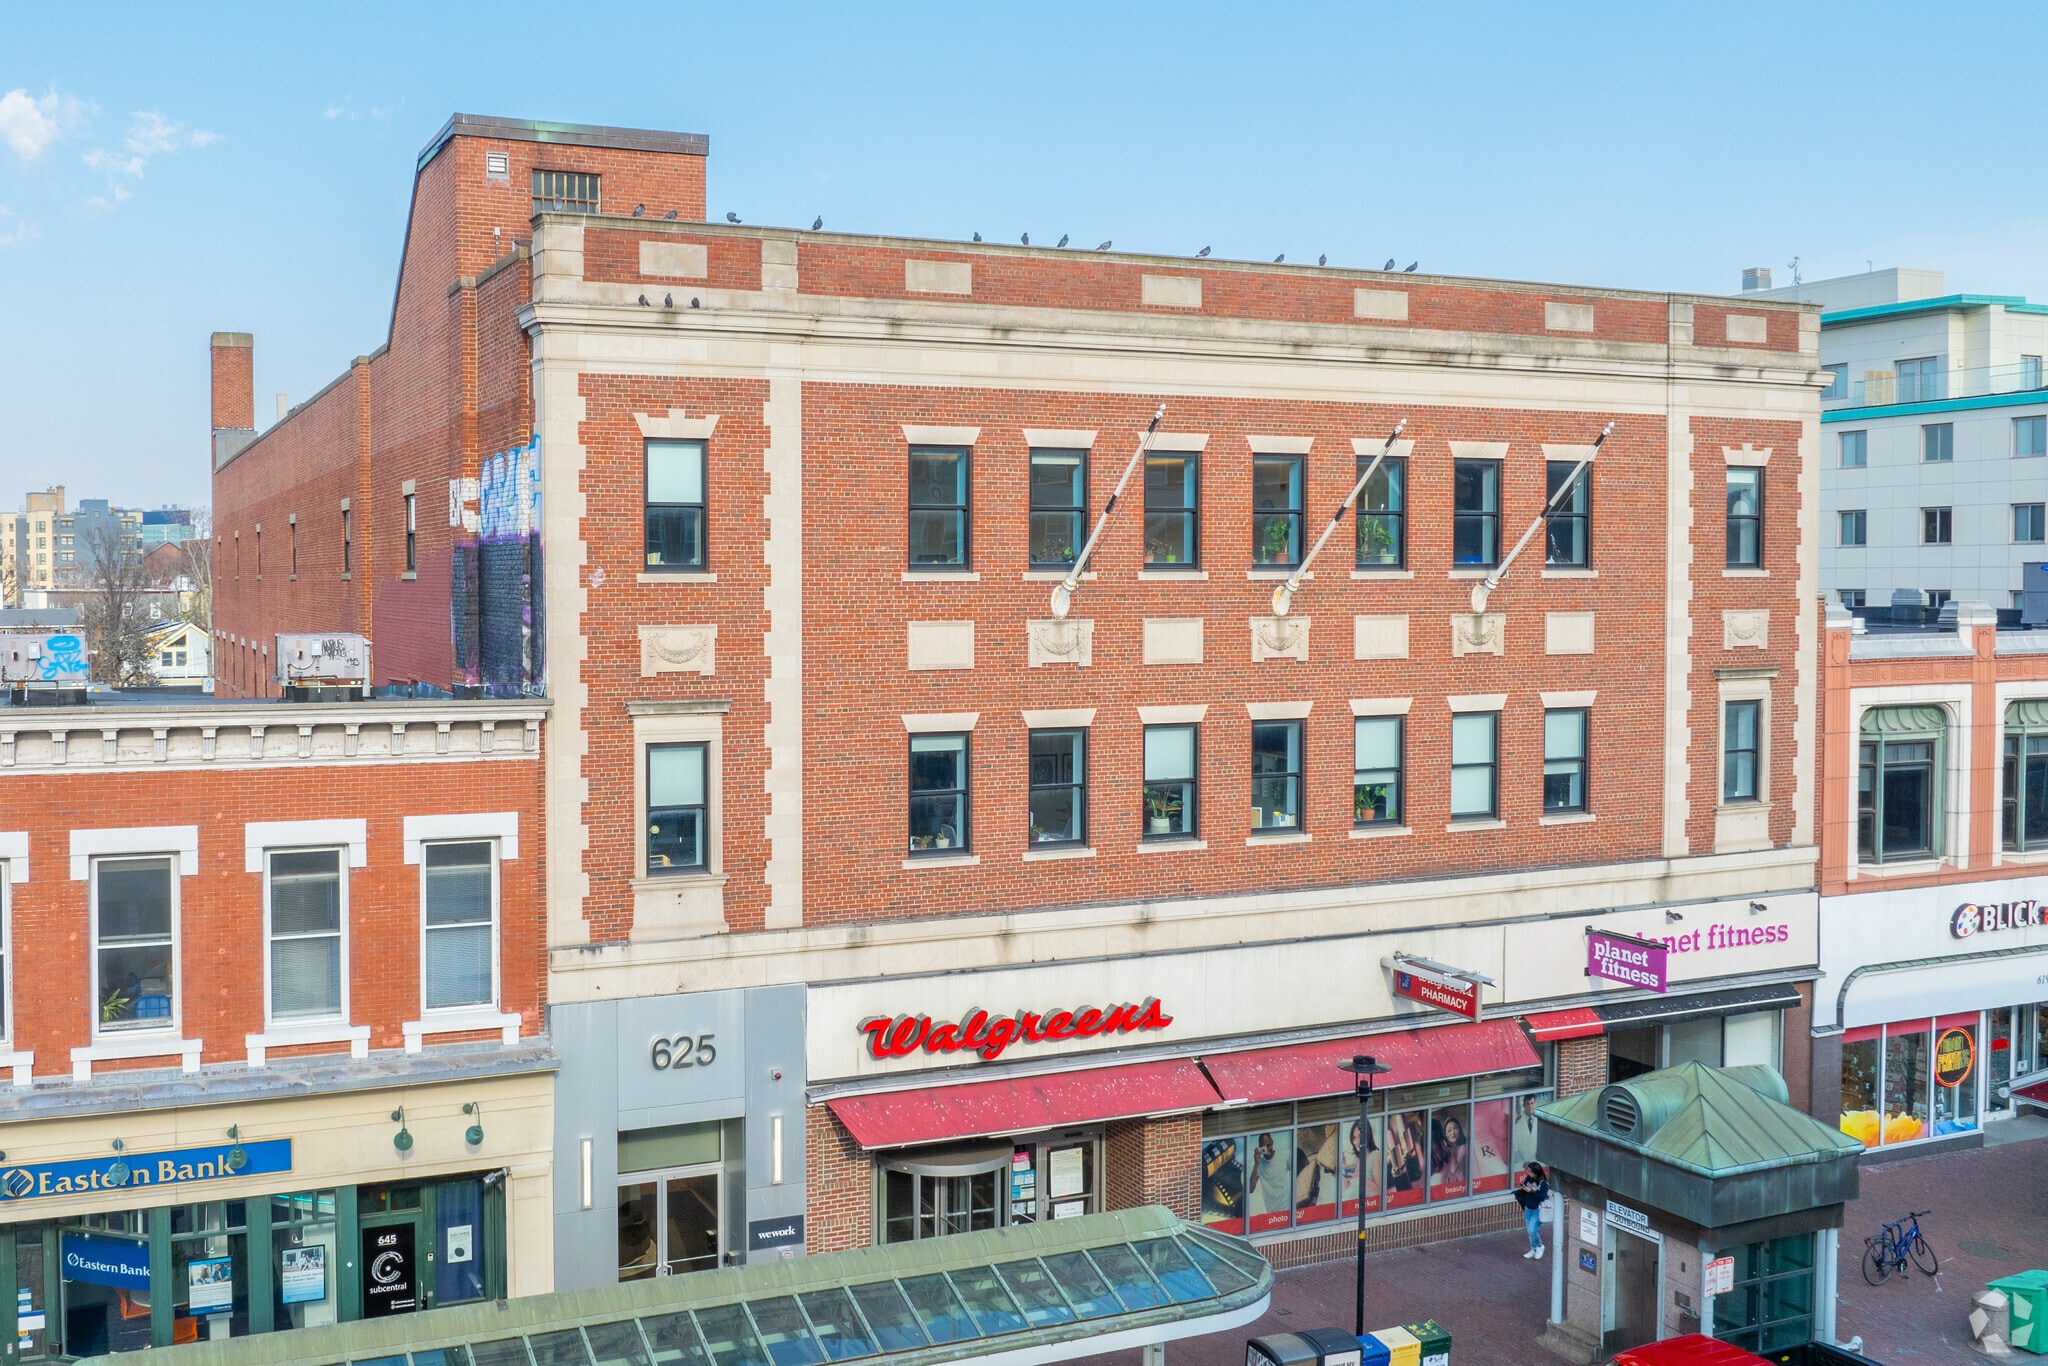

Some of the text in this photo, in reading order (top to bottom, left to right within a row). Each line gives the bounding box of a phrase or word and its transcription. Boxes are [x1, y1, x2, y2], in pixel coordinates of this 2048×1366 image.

[1982, 900, 2039, 932] BLICK
[1708, 923, 1789, 951] fitness
[1593, 939, 1649, 968] planet
[1600, 958, 1659, 988] fitness
[1419, 976, 1474, 998] geens
[1421, 987, 1468, 1011] PHARMACY
[858, 996, 1174, 1060] Walgreens
[650, 1034, 717, 1071] 625
[38, 1155, 235, 1195] Easten Bank
[1445, 1185, 1466, 1194] beauty
[1354, 1200, 1377, 1209] mket
[1609, 1202, 1646, 1224] ELEVATOR
[1268, 1214, 1289, 1225] photo
[378, 1234, 397, 1244] 645
[758, 1225, 796, 1239] wework
[79, 1257, 150, 1277] Eastern Bank
[369, 1281, 407, 1295] subcentral
